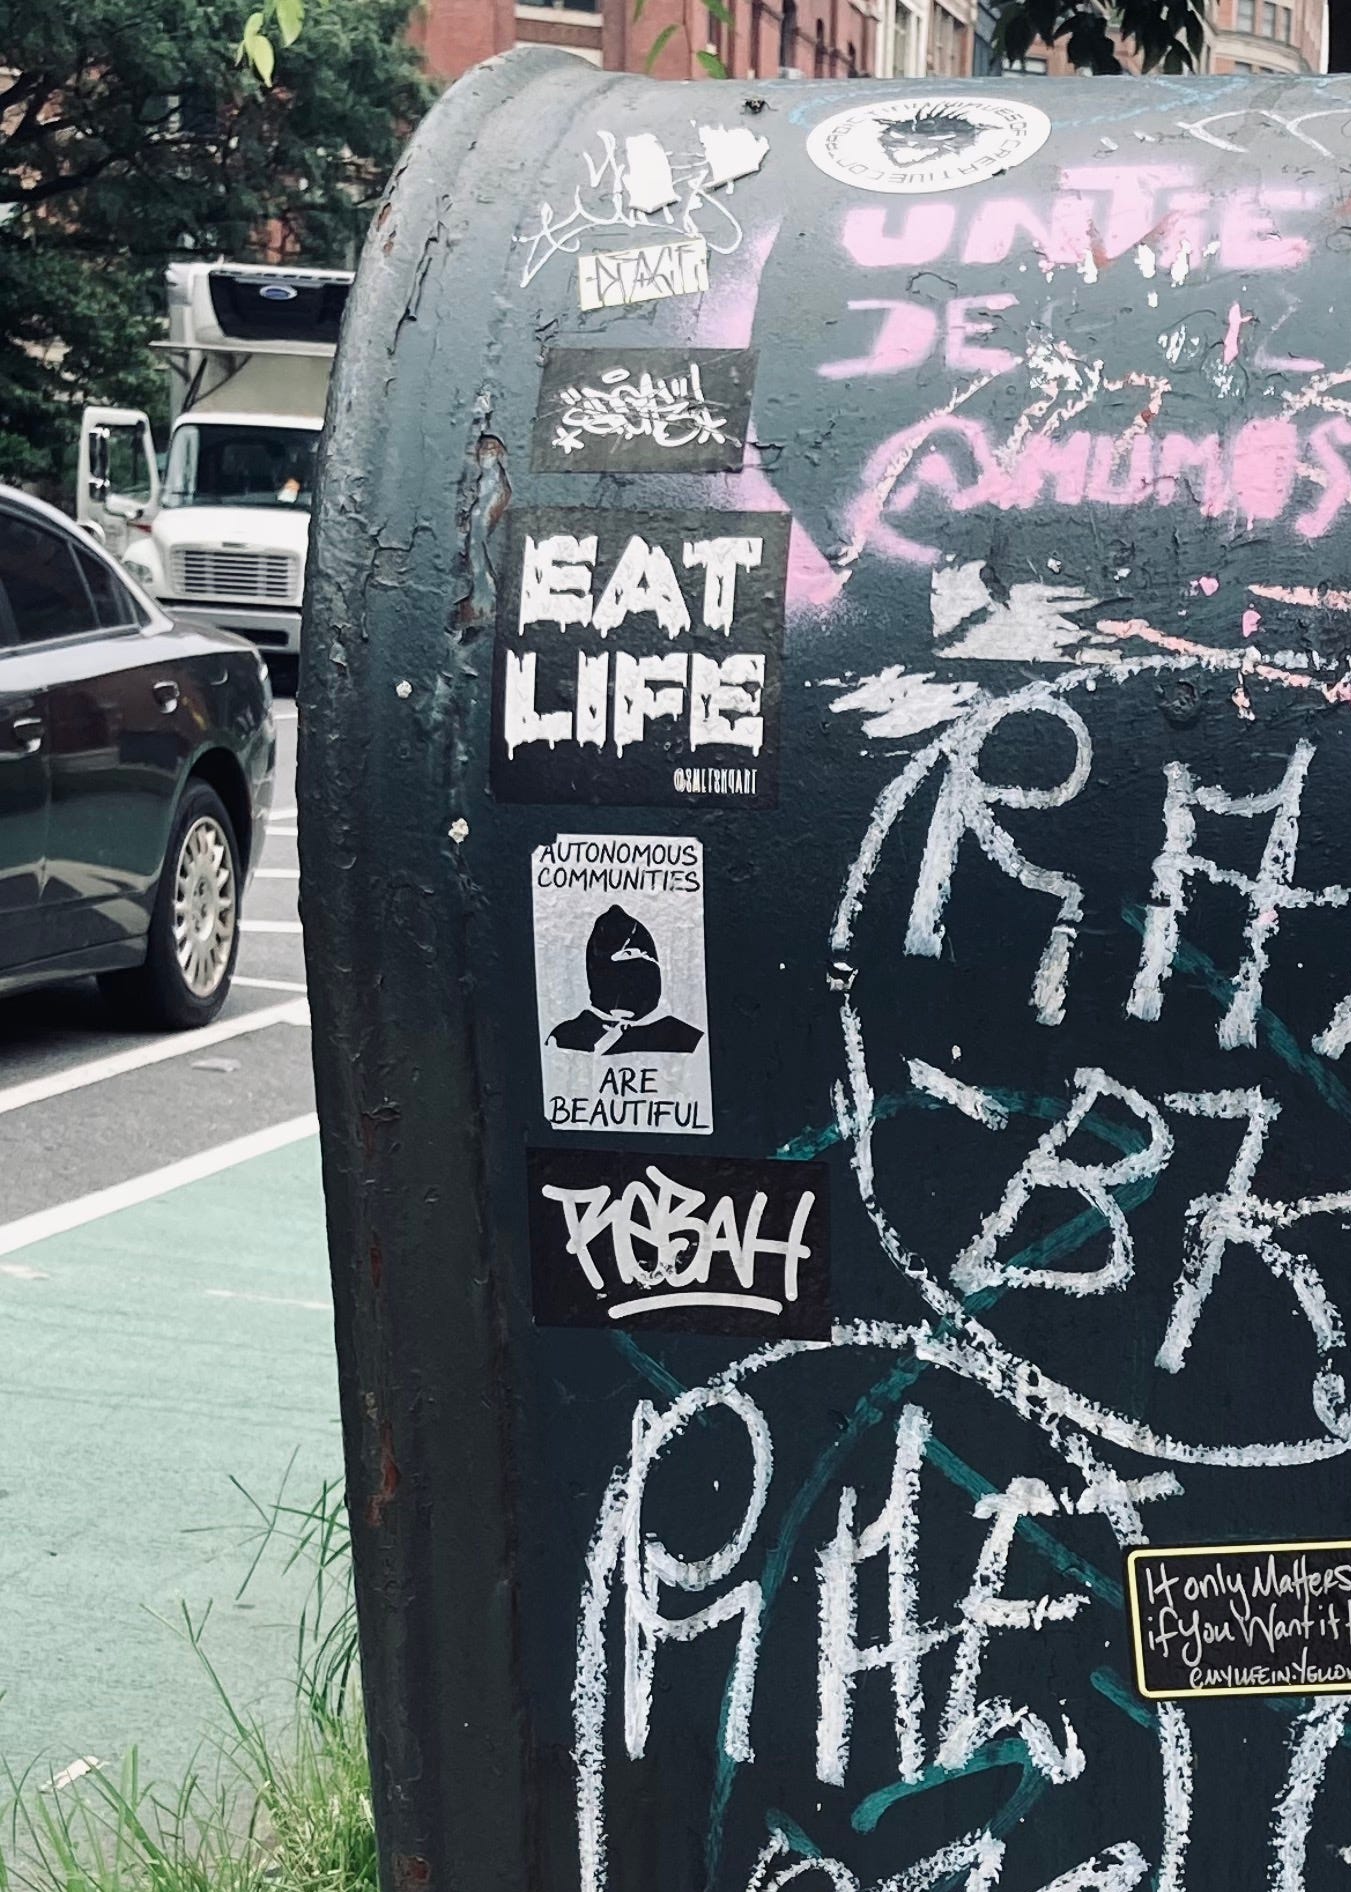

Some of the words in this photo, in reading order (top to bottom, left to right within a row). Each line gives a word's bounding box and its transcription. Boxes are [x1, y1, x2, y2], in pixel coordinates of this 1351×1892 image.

[518, 534, 764, 641] EAT
[503, 649, 767, 761] LIFE
[538, 840, 699, 867] AUTONOMOUS
[537, 866, 702, 893] COMMUNITIES
[600, 1067, 659, 1096] ARE
[549, 1096, 710, 1130] BEAUTIFUL
[1145, 1562, 1180, 1609] It
[1183, 1562, 1251, 1621] only
[1147, 1605, 1178, 1658] if
[1319, 1603, 1341, 1641] it
